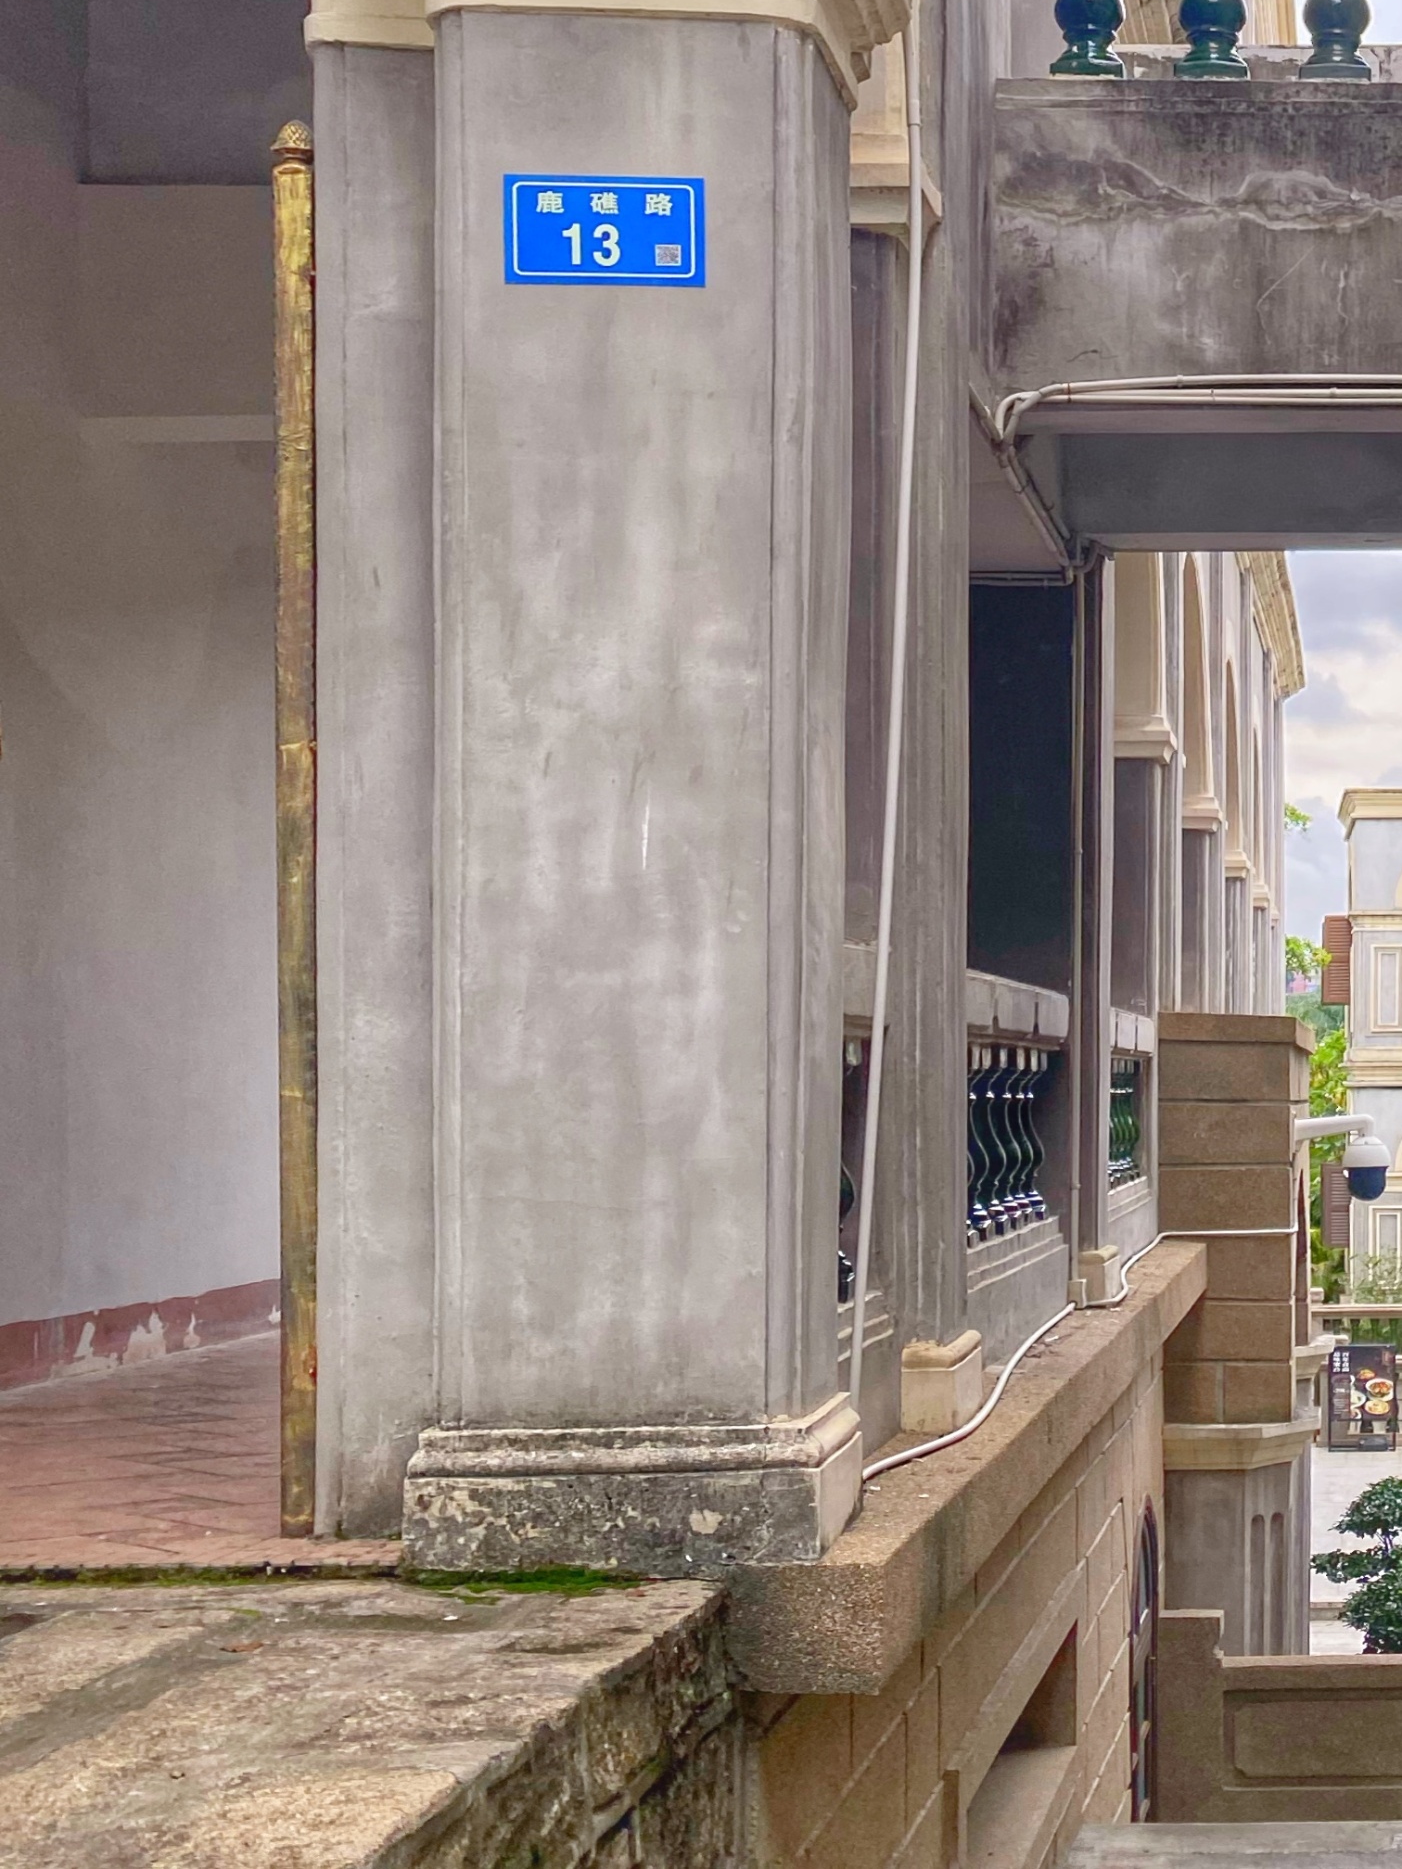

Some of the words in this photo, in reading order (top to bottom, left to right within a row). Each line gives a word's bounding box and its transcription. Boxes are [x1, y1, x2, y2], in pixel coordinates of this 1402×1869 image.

[536, 190, 673, 216] 鹿礁路
[562, 223, 621, 267] 13
